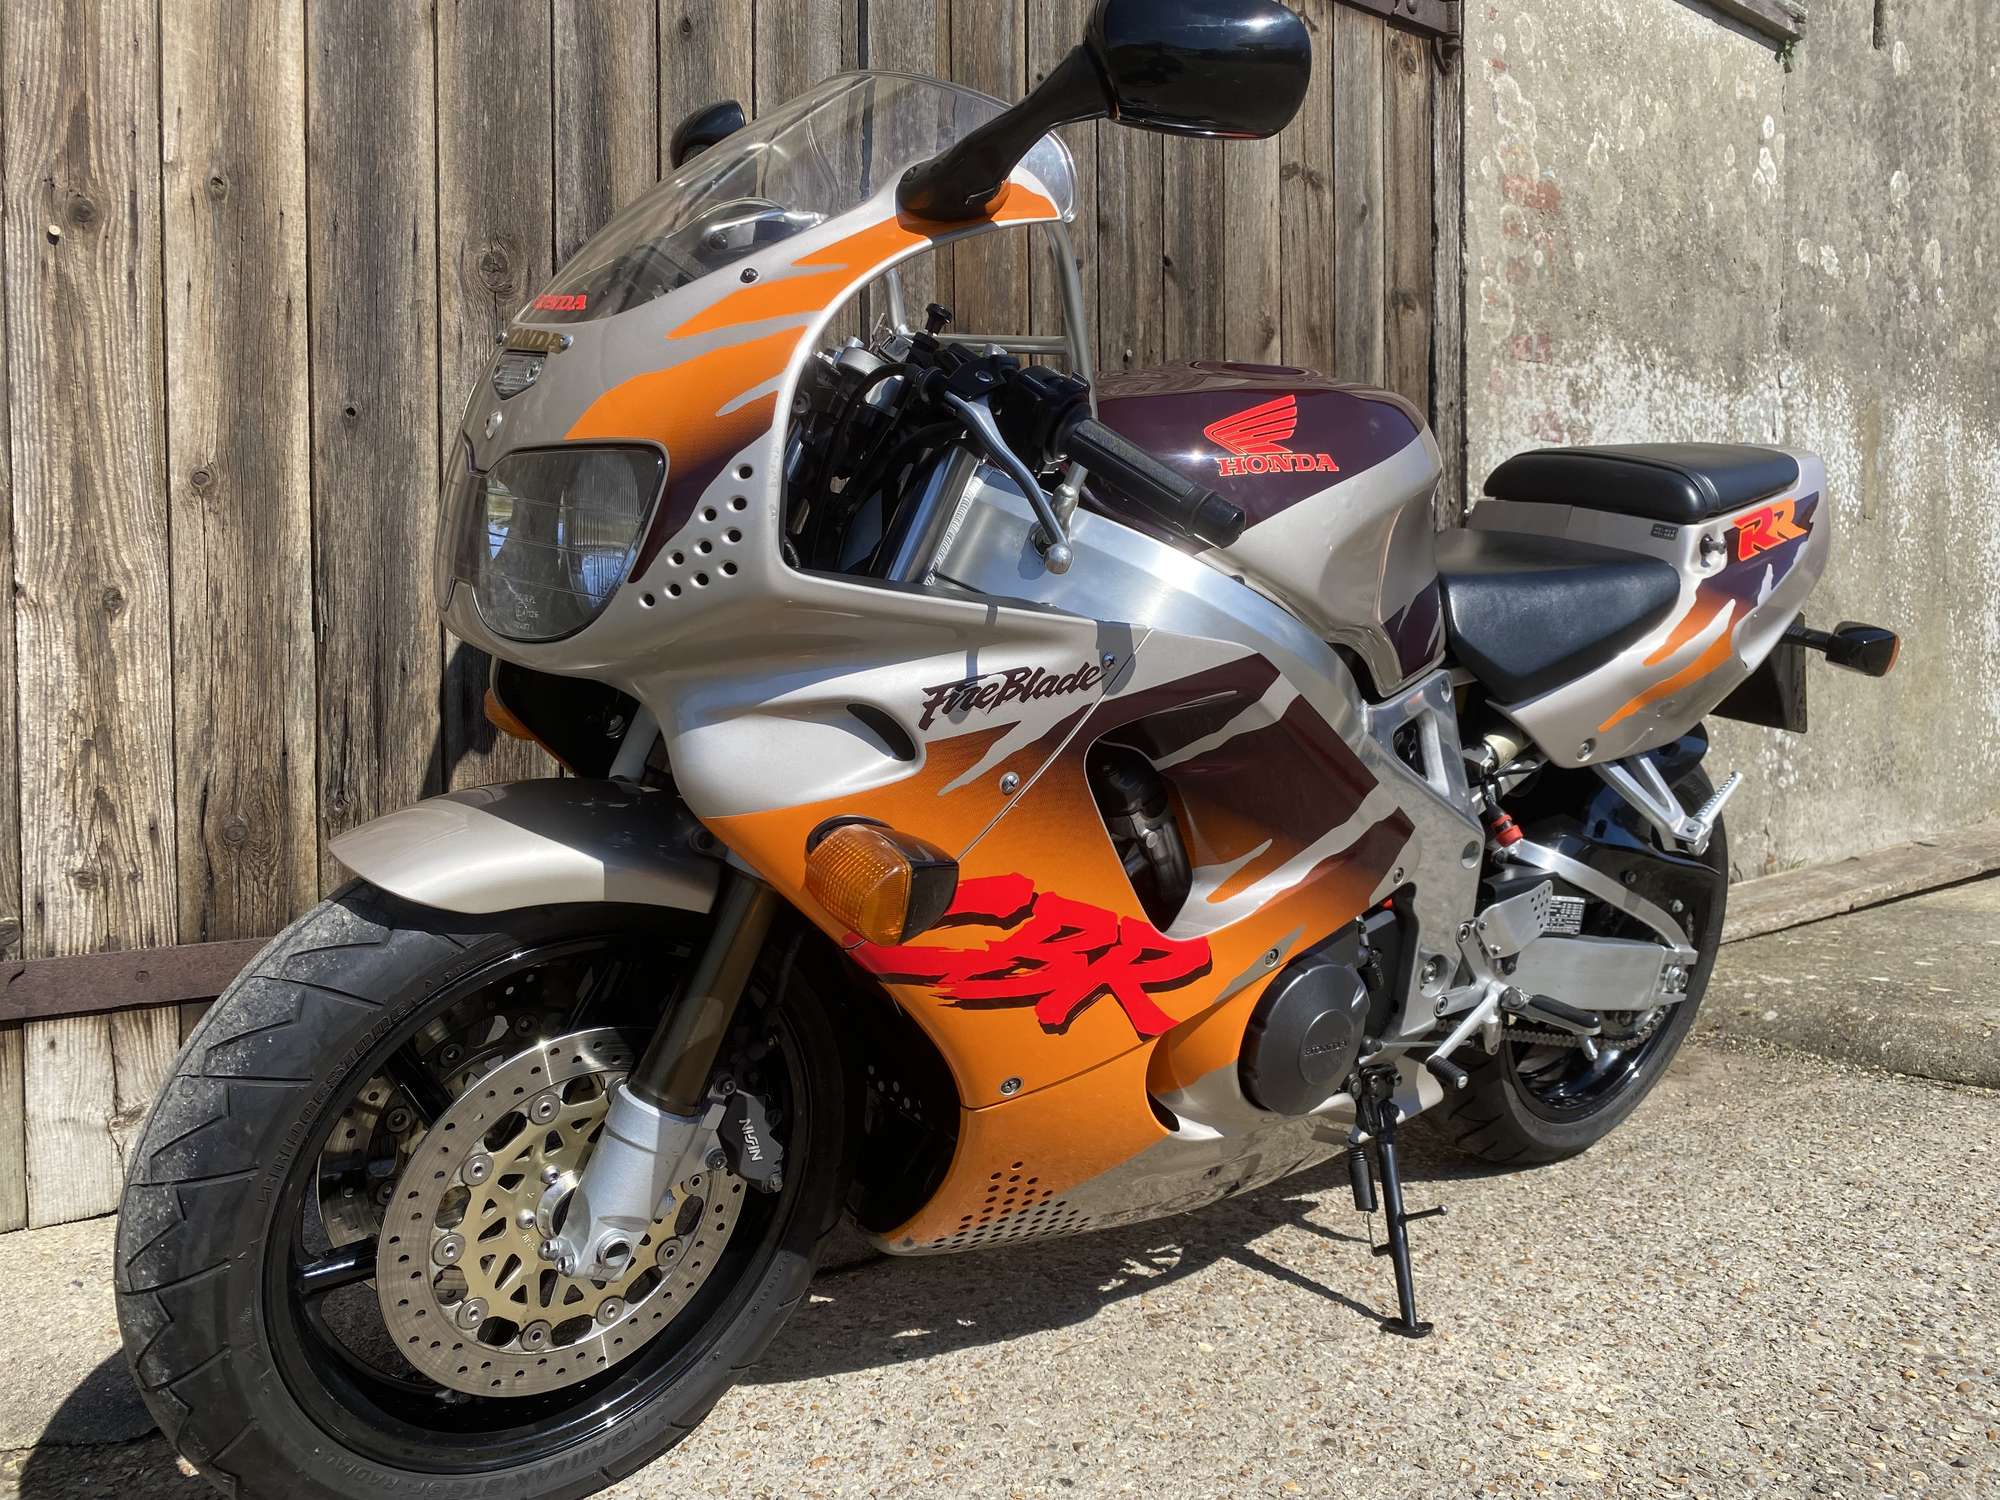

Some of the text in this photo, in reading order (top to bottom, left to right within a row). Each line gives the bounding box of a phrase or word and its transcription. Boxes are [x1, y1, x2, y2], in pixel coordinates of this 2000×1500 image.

[1214, 453, 1340, 477] HONDA
[1733, 498, 1808, 562] RR
[918, 661, 1107, 731] FireBlade
[738, 1118, 764, 1161] NISSIN
